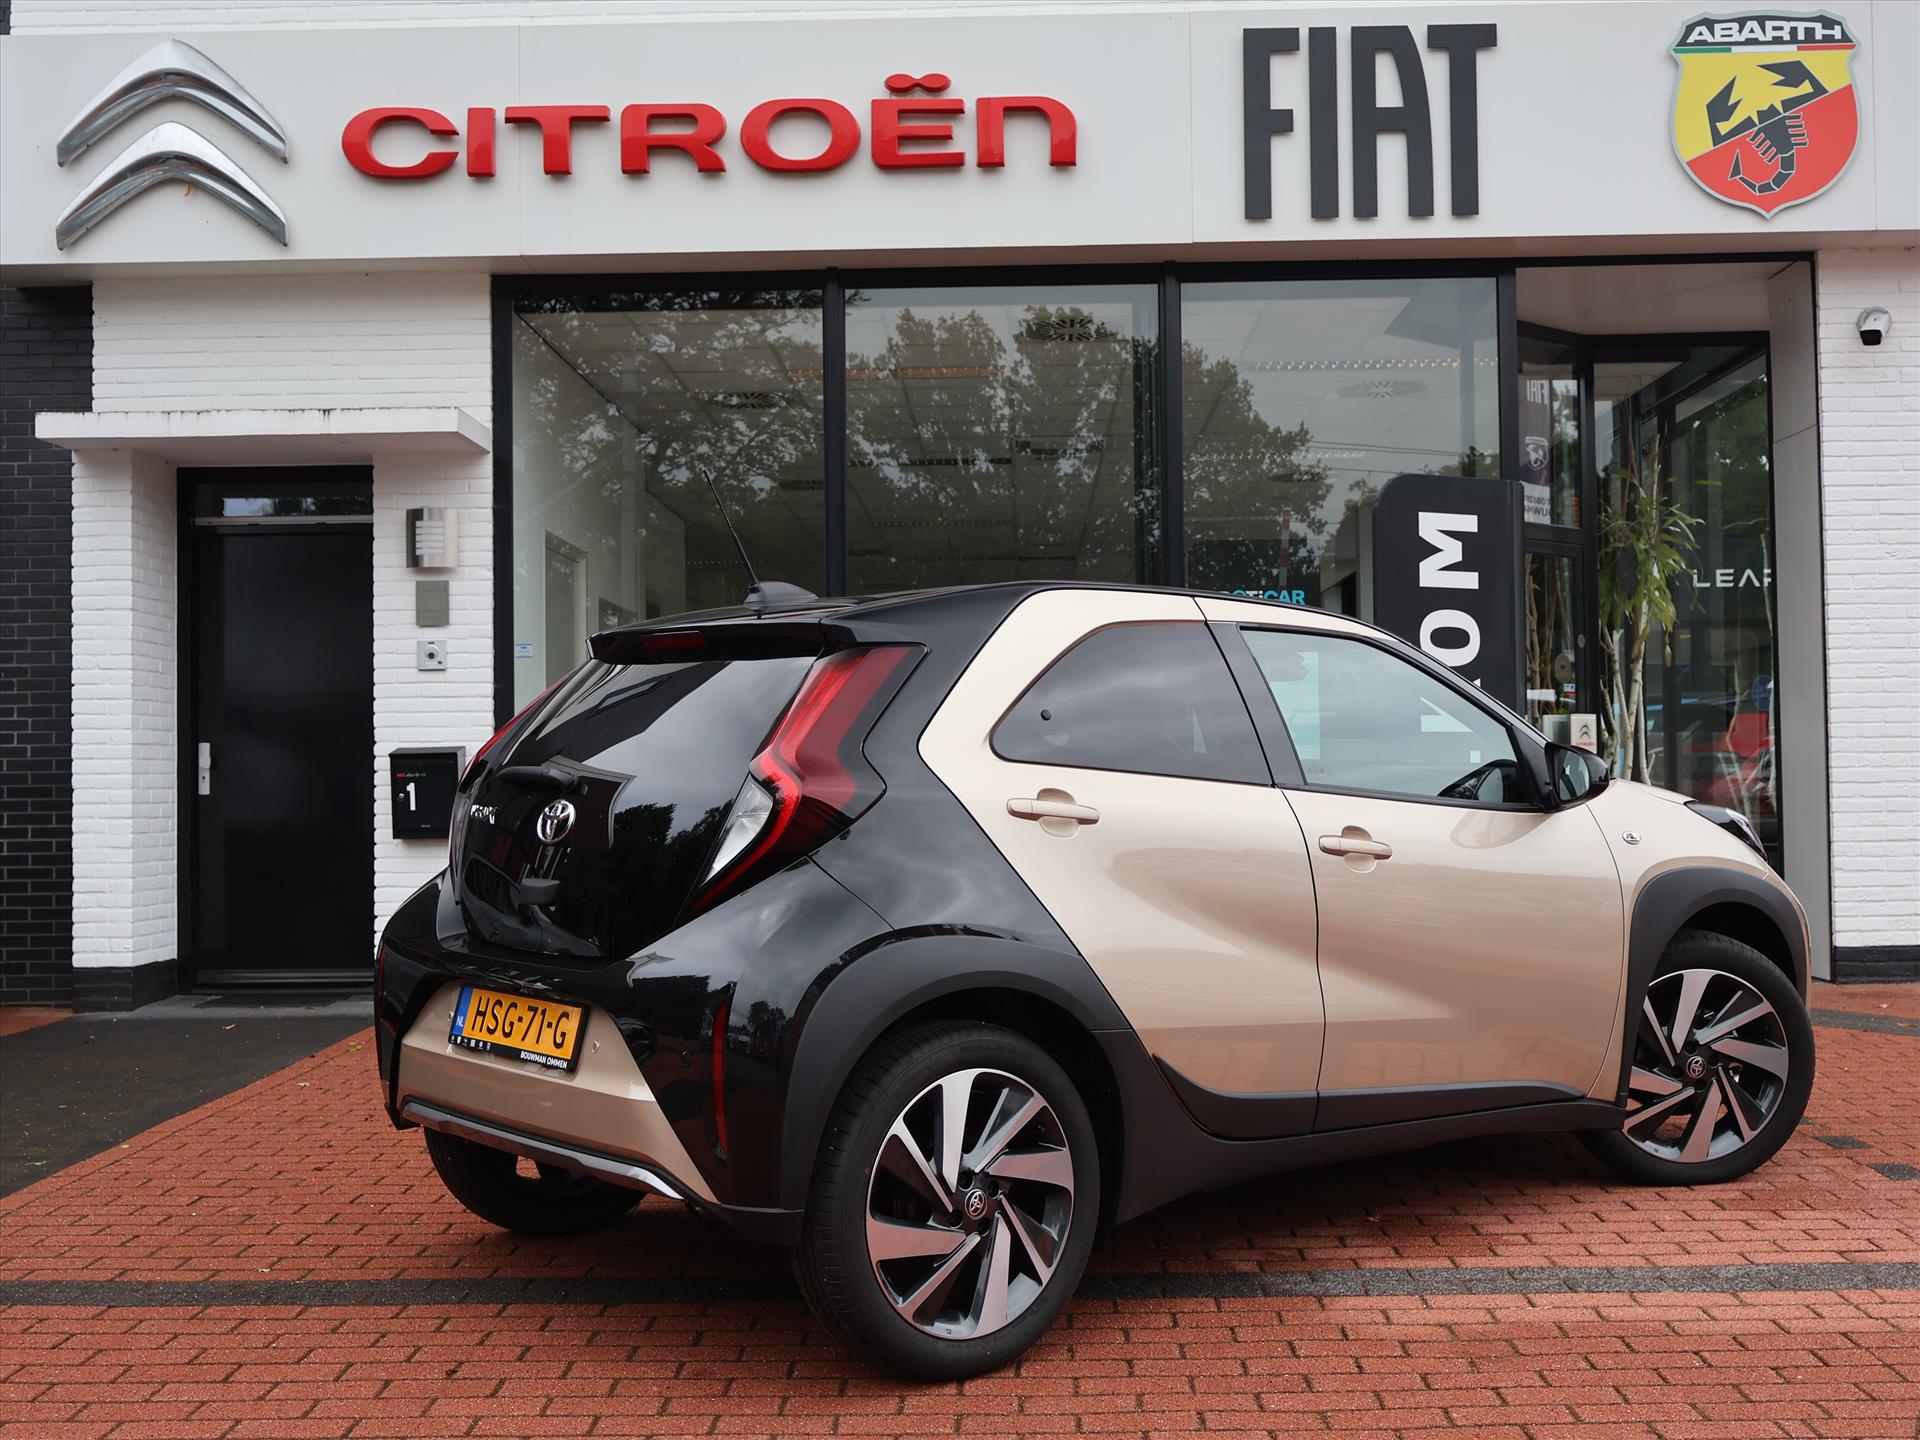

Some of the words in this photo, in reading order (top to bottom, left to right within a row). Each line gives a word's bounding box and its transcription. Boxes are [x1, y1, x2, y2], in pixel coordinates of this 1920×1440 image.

[1686, 20, 1842, 43] ABARTH
[341, 73, 1077, 179] CITROËN
[1243, 23, 1497, 219] FIAT
[406, 782, 416, 811] 1
[455, 1015, 464, 1027] NL
[471, 995, 570, 1049] HSG-71-G
[520, 1050, 547, 1064] BOUWMAN
[546, 1057, 568, 1069] OMMEN
